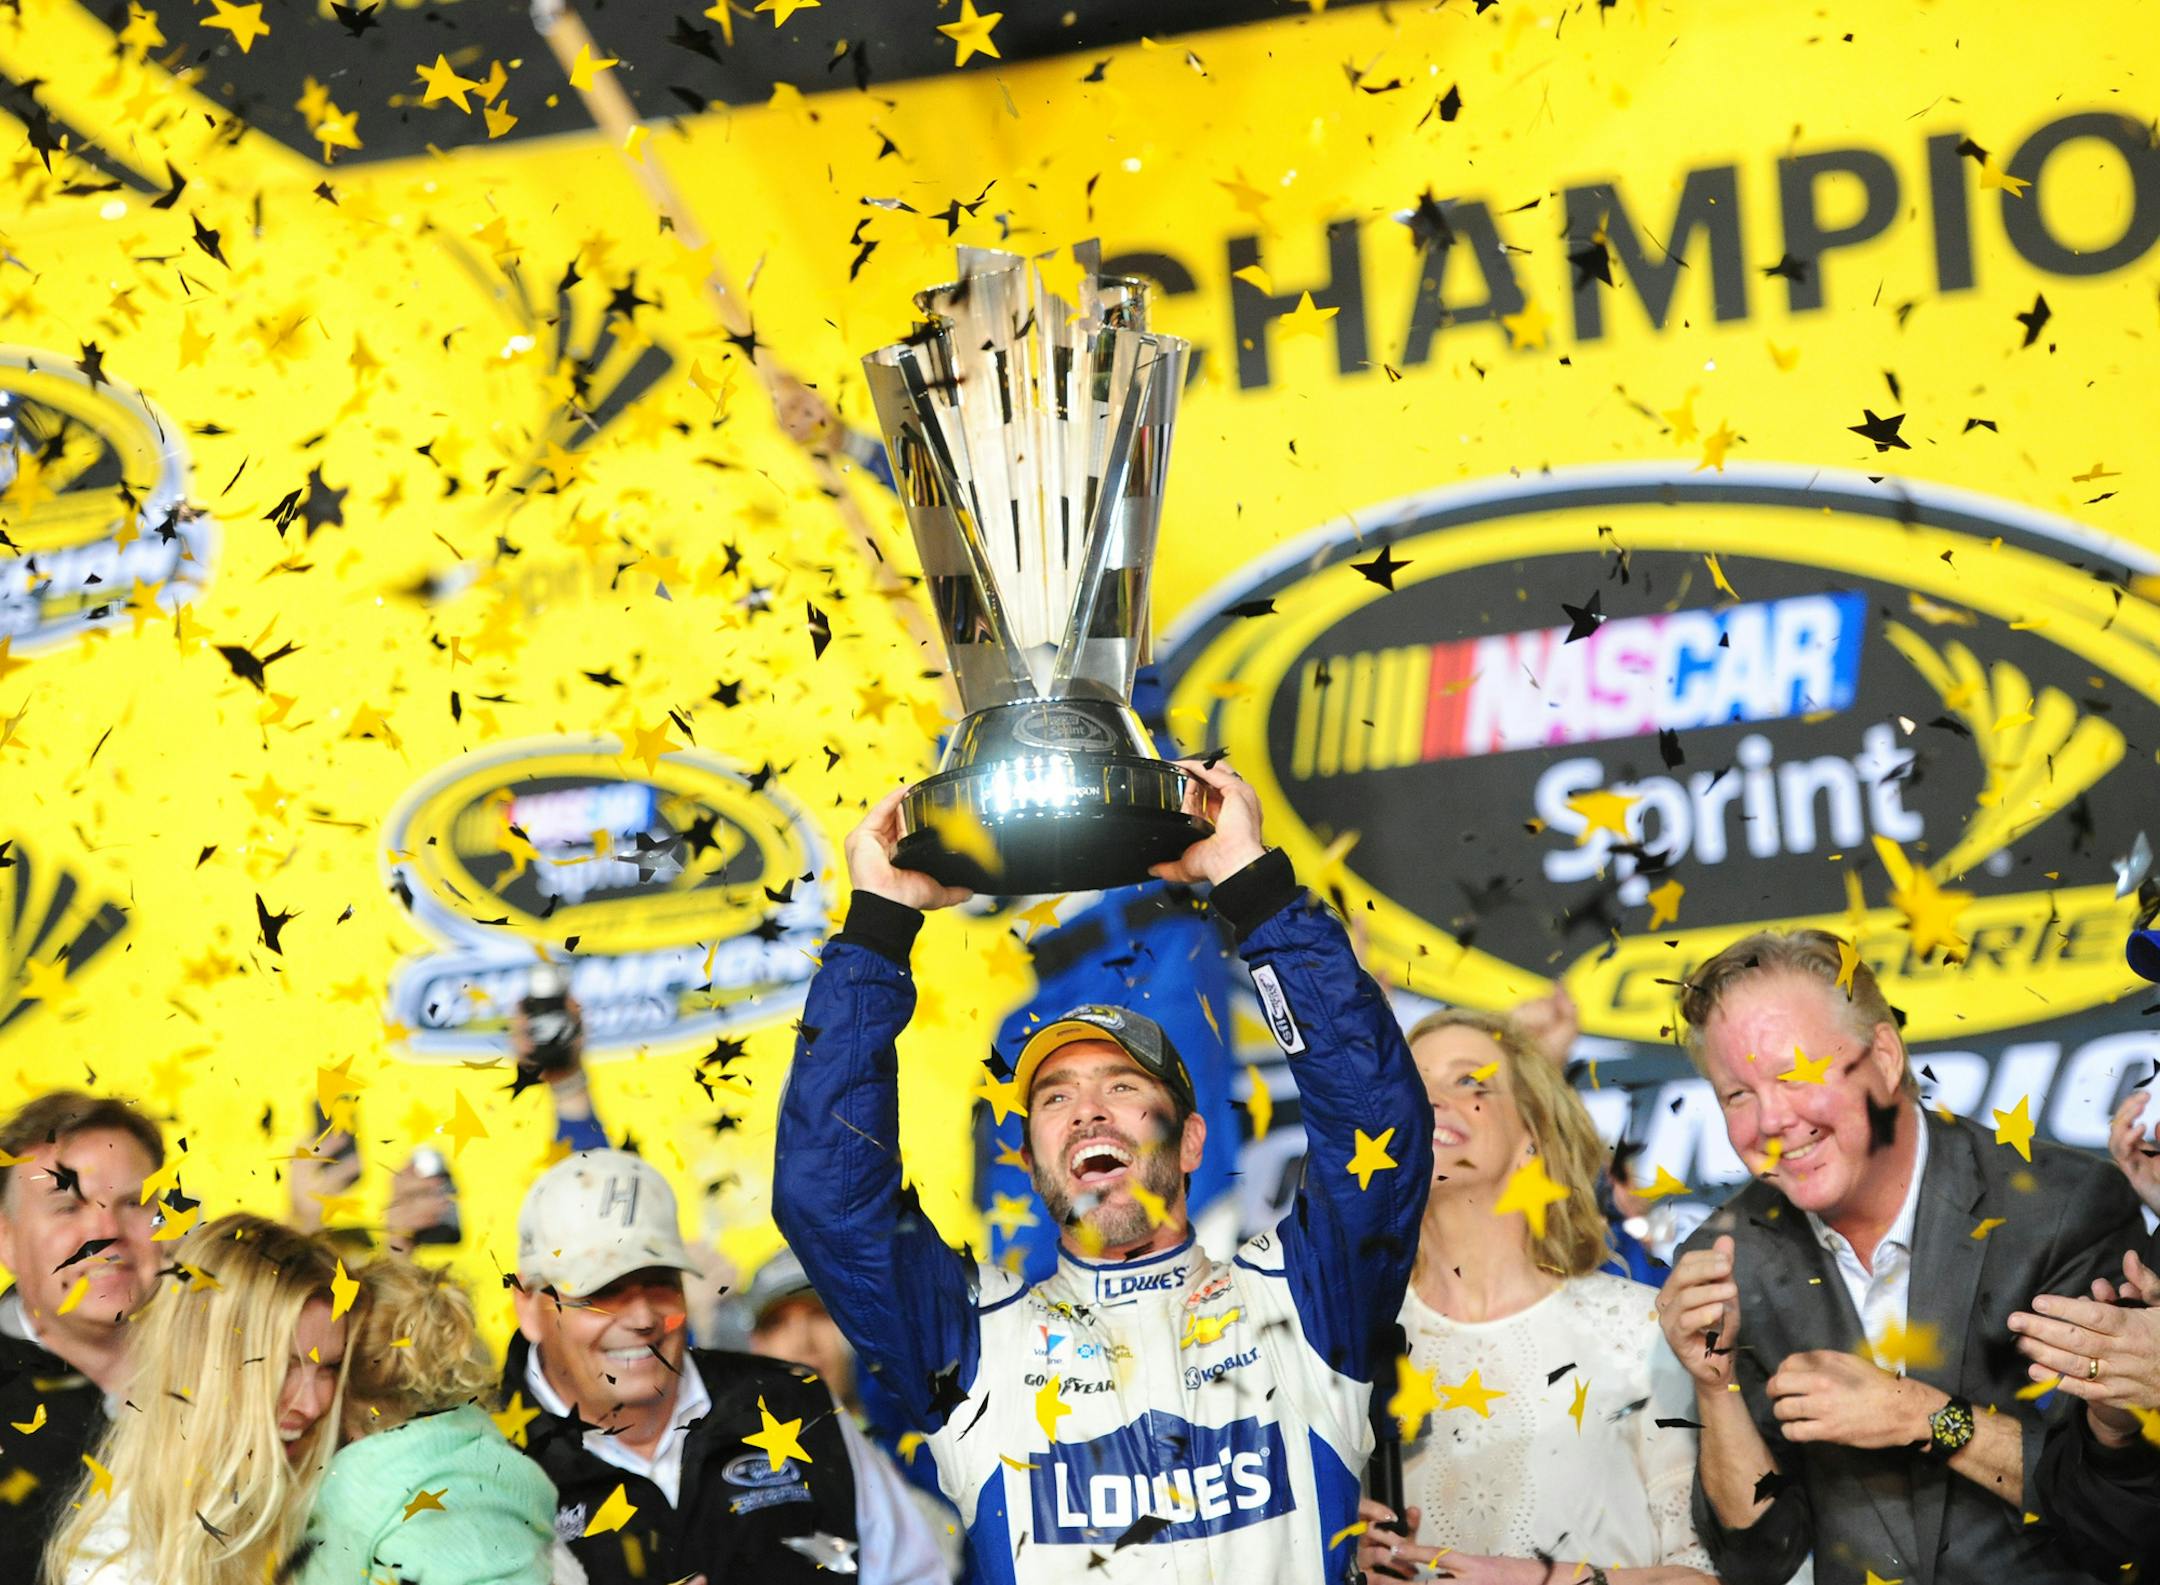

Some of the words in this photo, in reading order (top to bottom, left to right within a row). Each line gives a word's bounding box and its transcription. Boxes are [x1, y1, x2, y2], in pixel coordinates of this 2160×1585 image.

[1466, 596, 1842, 757] NASCAR
[1533, 722, 1925, 906] Sprint
[1024, 1374, 1116, 1396] GOYEAR
[1202, 1347, 1258, 1382] KOBALT
[1054, 1448, 1272, 1529] LOWE'S
